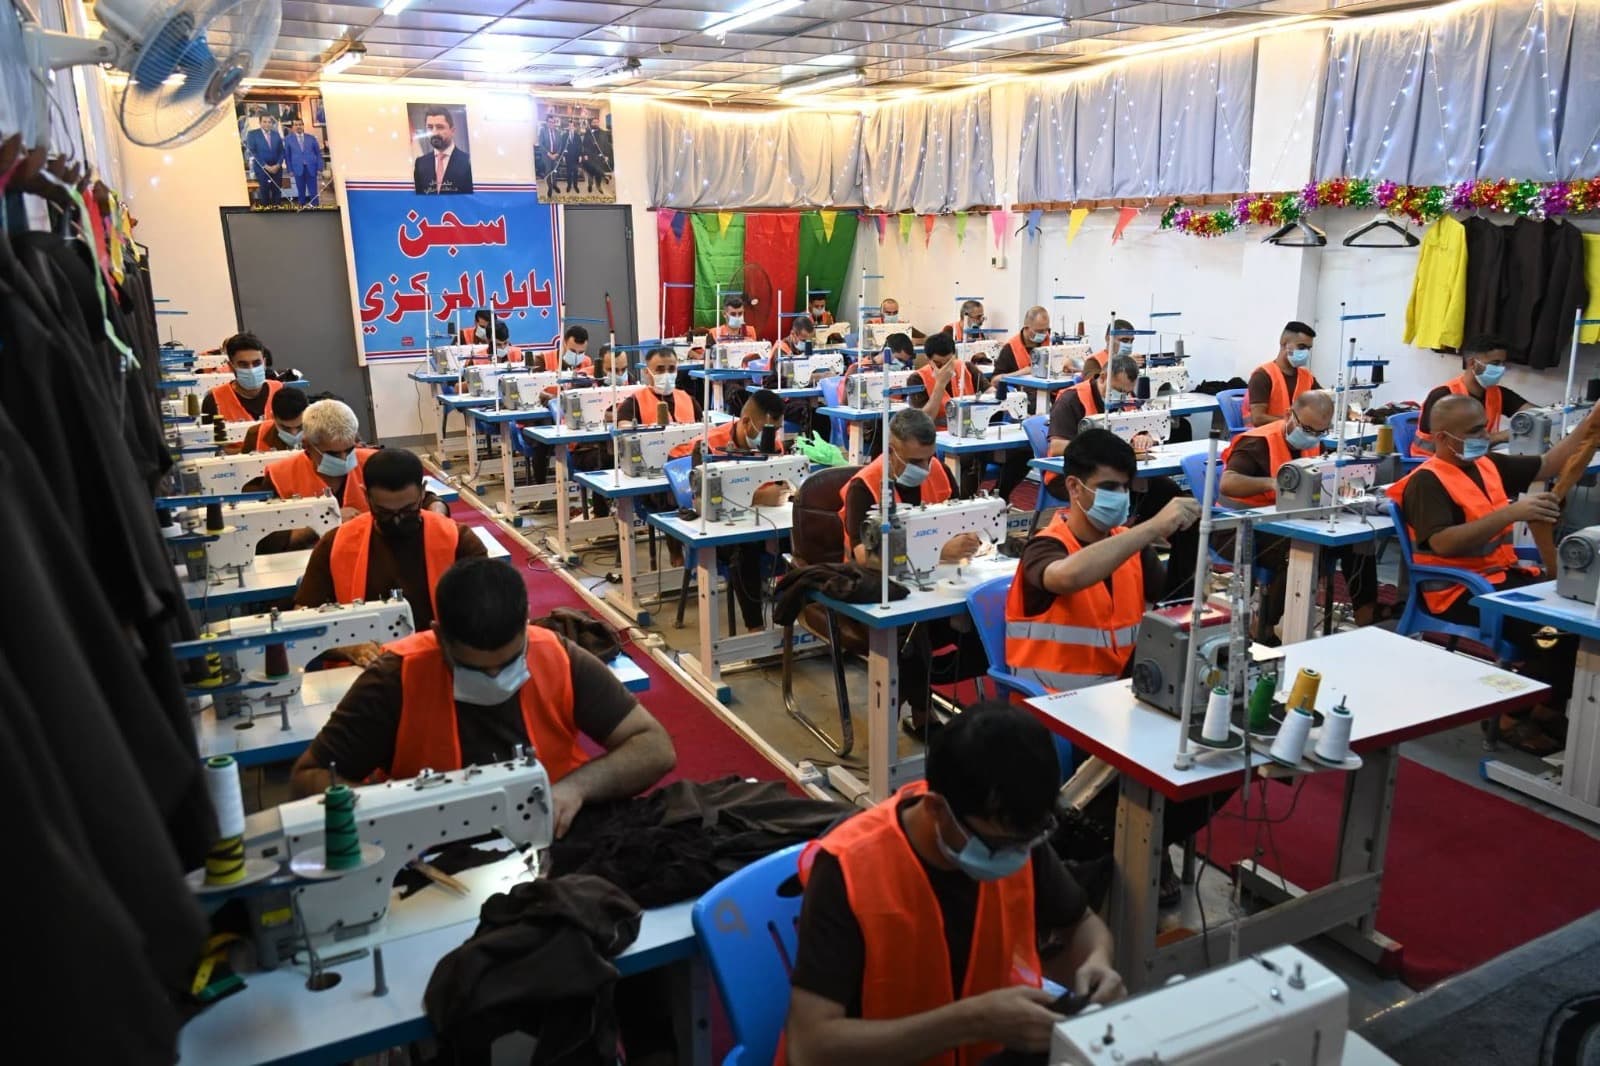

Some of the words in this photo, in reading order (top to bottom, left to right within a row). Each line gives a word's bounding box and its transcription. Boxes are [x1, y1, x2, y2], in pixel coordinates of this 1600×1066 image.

[398, 209, 507, 259] سجن
[360, 269, 486, 335] المركزي
[491, 268, 552, 320] بابل
